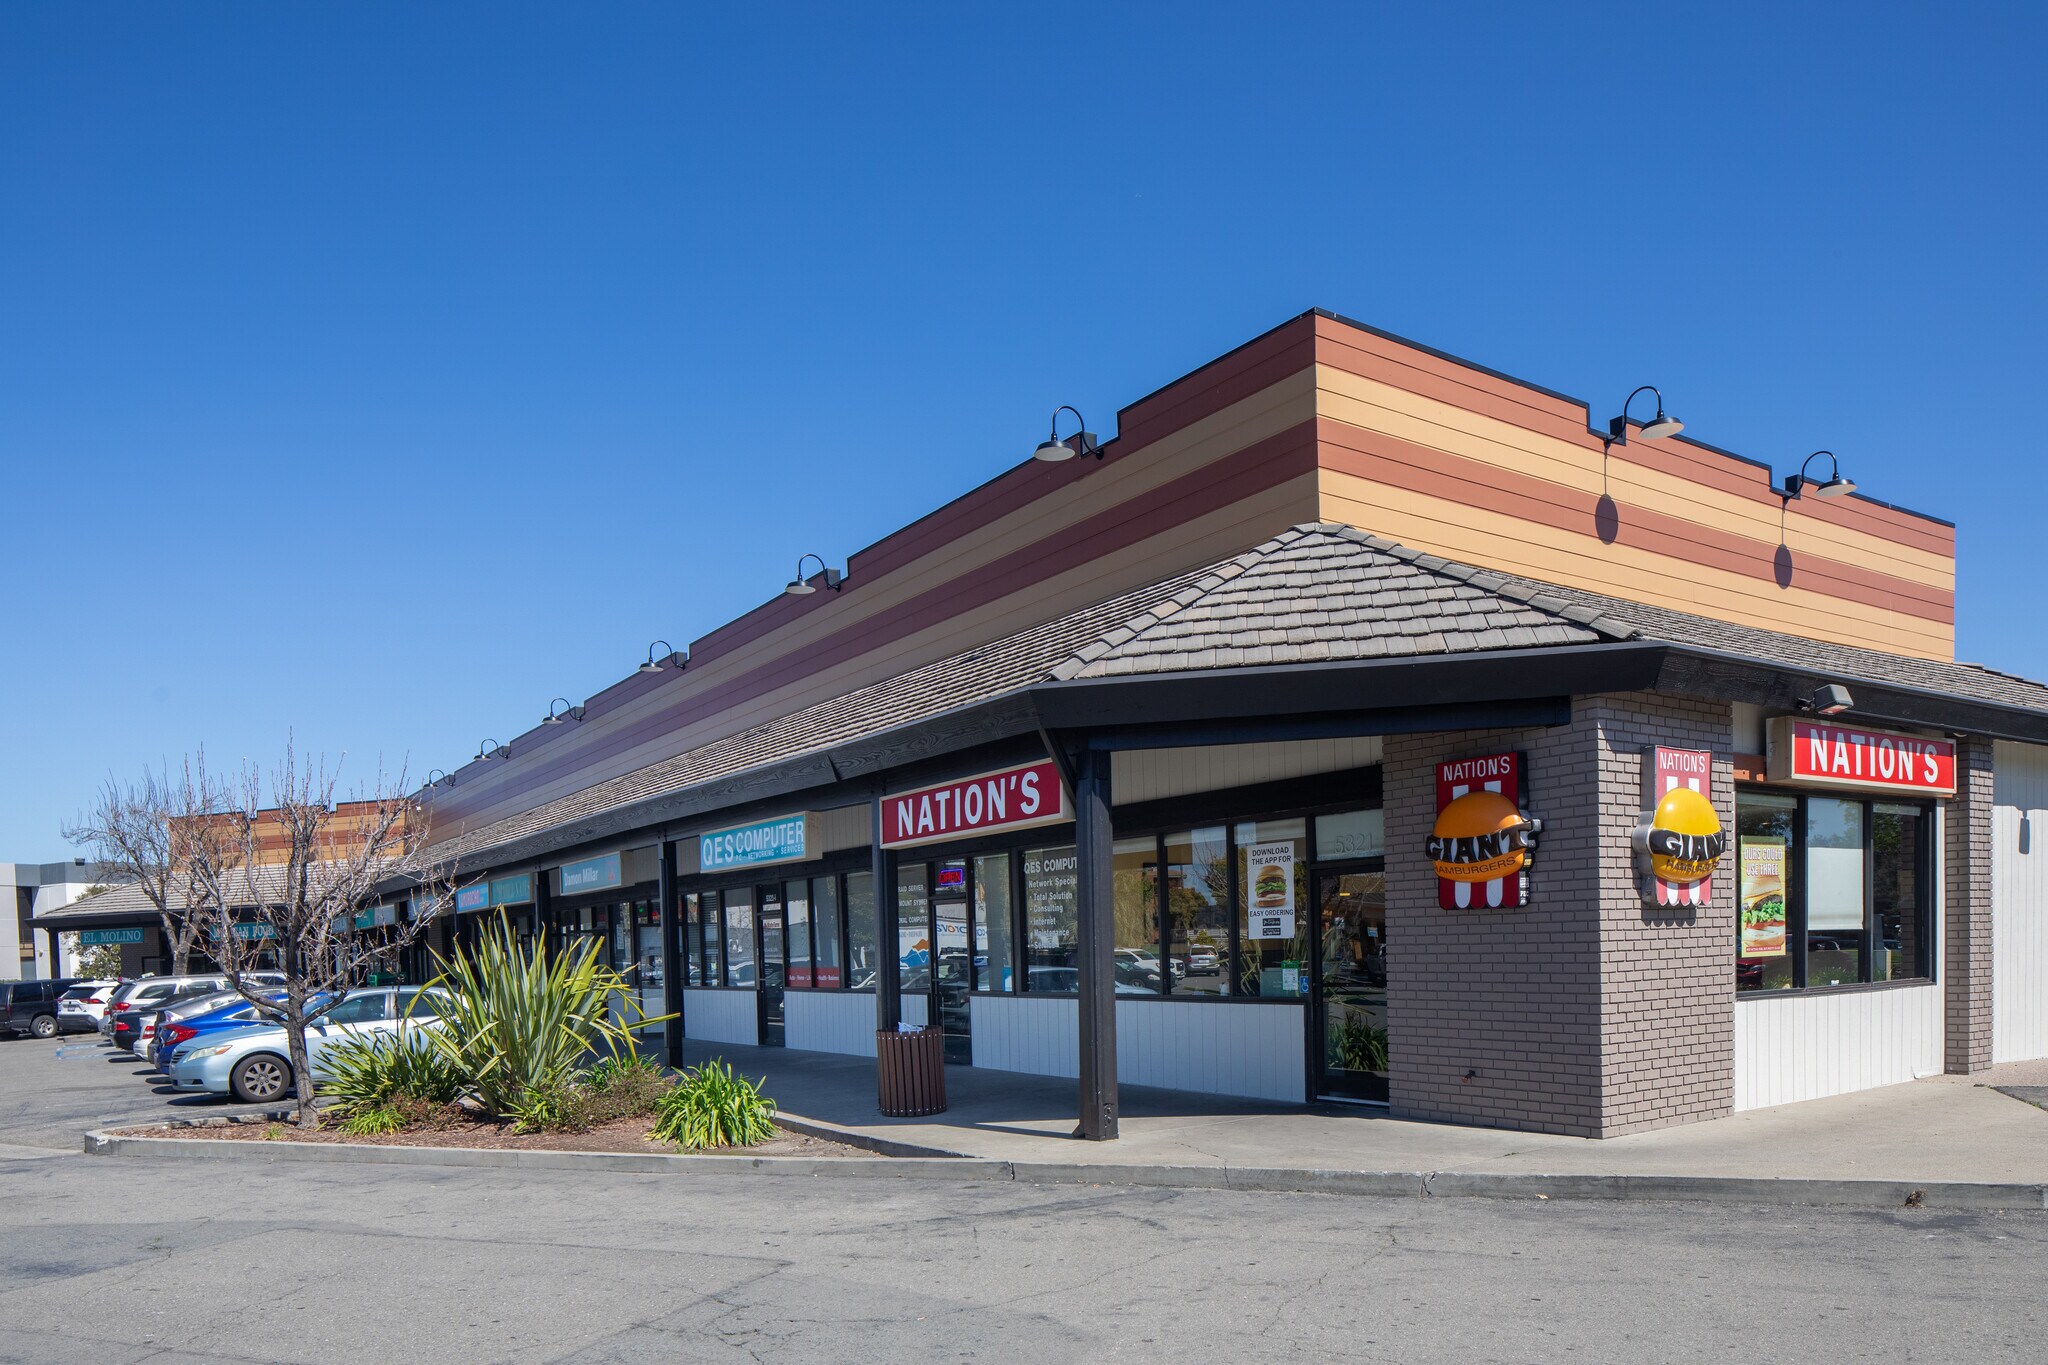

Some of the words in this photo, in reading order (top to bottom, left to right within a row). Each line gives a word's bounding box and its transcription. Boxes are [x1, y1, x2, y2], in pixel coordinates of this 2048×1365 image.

[1660, 752, 1706, 773] NATION'S
[1810, 729, 1939, 783] NATION'S
[1443, 756, 1511, 782] NATION'S
[898, 771, 1040, 837] NATION'S
[703, 834, 734, 866] QES
[736, 821, 804, 853] COMPUTER
[1334, 832, 1373, 854] 5321
[1425, 821, 1531, 863] GIANT
[748, 849, 775, 859] NETWORKING
[781, 843, 804, 854] SERVICES
[1252, 846, 1290, 857] DOWNLOAD
[1744, 847, 1760, 860] OURS
[1762, 848, 1783, 861] COULD
[1278, 855, 1291, 863] FOR
[1024, 861, 1041, 875] QES
[1746, 863, 1759, 876] USE
[1760, 863, 1778, 876] THREE
[564, 873, 582, 887] Damon
[940, 872, 961, 884] OPEN
[1028, 880, 1053, 888] Network
[1033, 893, 1048, 901] Total
[1049, 891, 1073, 900] Solution
[1033, 904, 1064, 913] Consulting
[1033, 917, 1056, 925] Internet
[83, 932, 96, 942] EL
[100, 930, 141, 942] MOLINO
[1033, 929, 1070, 937] Maintenance
